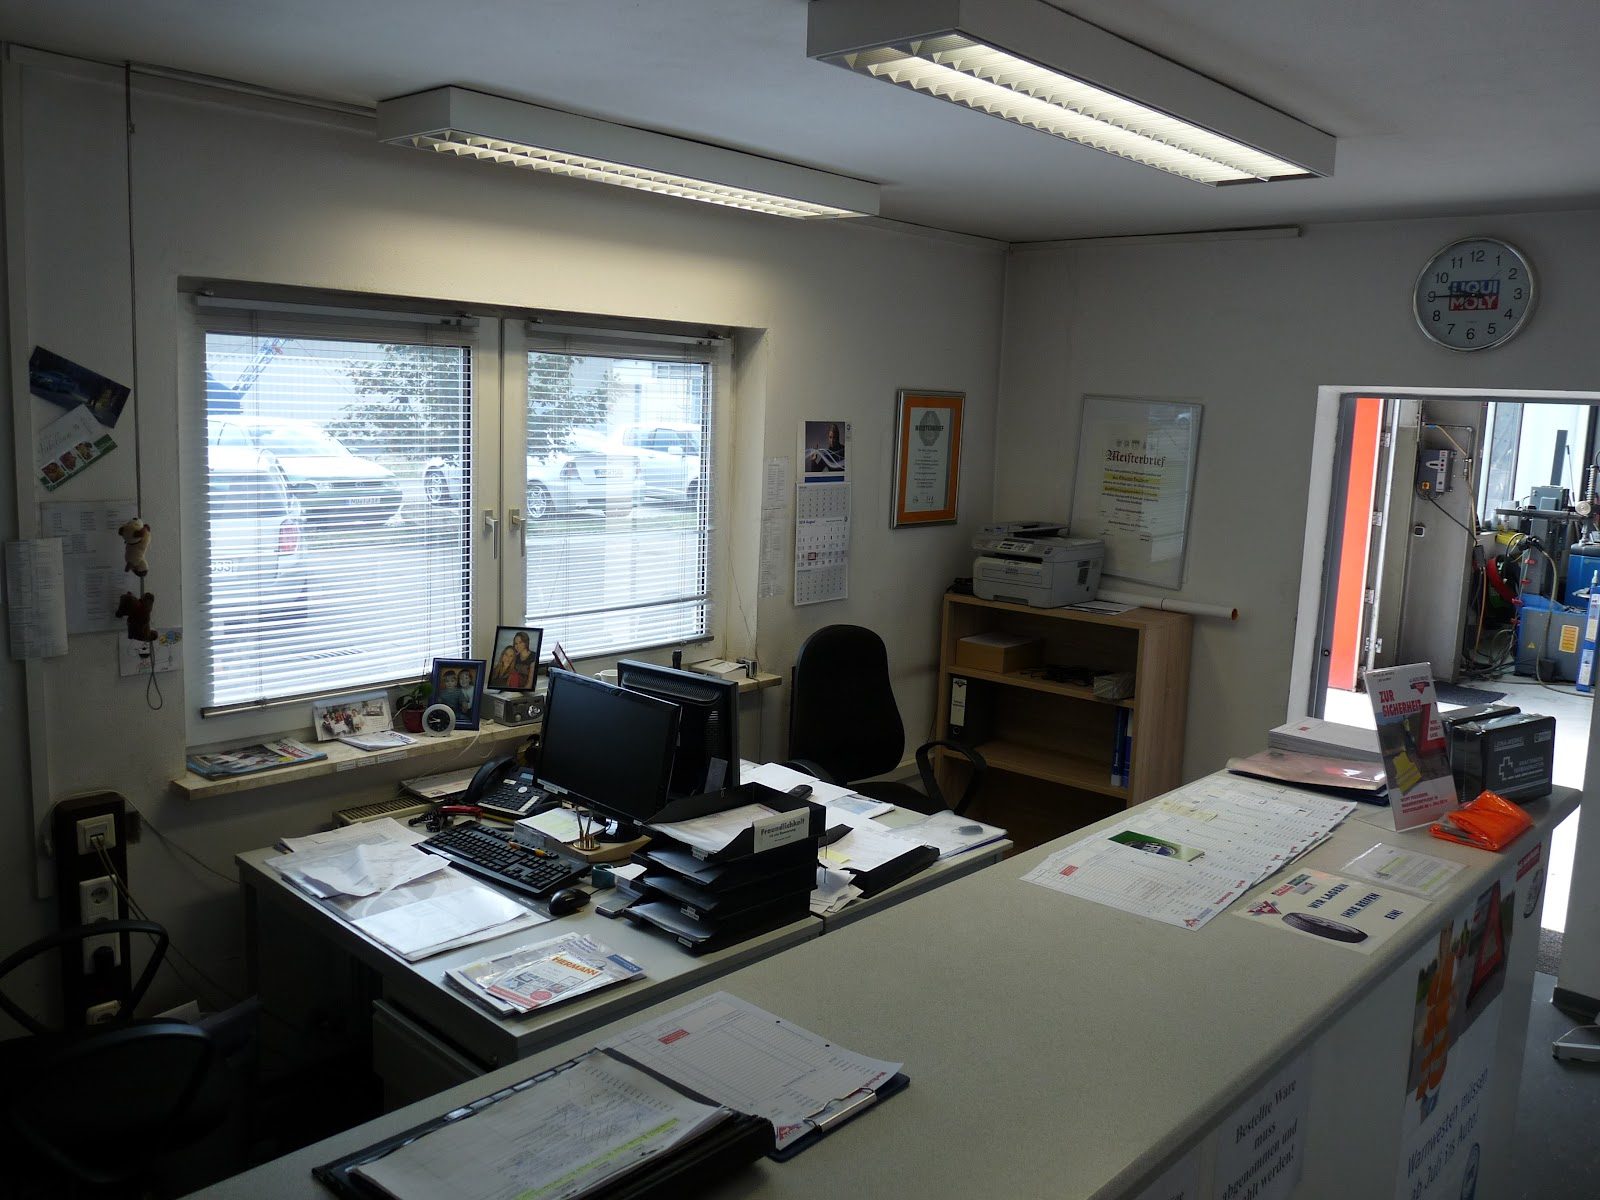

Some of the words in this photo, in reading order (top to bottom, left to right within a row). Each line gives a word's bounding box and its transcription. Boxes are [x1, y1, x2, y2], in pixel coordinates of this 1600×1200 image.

[1470, 250, 1485, 263] 12
[1495, 255, 1502, 267] 1
[1451, 257, 1463, 270] 11
[1435, 271, 1449, 284] 10
[1508, 268, 1518, 280] 2
[1452, 280, 1499, 295] LIQUI
[1514, 288, 1522, 300] 3
[1427, 291, 1436, 303] 9
[1450, 295, 1498, 311] MOLY
[1432, 310, 1441, 322] 8
[1504, 309, 1513, 320] 4
[1447, 323, 1456, 335] 7
[1466, 328, 1475, 340] 6
[1487, 323, 1496, 334] 5
[1378, 689, 1395, 703] ZUR
[1382, 699, 1422, 718] SICHERHEIT
[1307, 896, 1326, 910] WIR
[1322, 883, 1350, 901] LAGERN
[1340, 903, 1361, 919] IHRE
[1358, 892, 1382, 911] REIFEN
[1384, 909, 1404, 921] EIN!
[551, 956, 600, 977] HERMANN
[1235, 1101, 1273, 1144] Bestellte
[1275, 1080, 1297, 1105] Ware
[1458, 1103, 1481, 1147] Auto!
[1254, 1121, 1277, 1150] muss
[1408, 1105, 1459, 1179] Warnwesten
[1222, 1139, 1280, 1200] abgenommen
[1281, 1118, 1298, 1146] und
[1260, 1144, 1295, 1188] werden!
